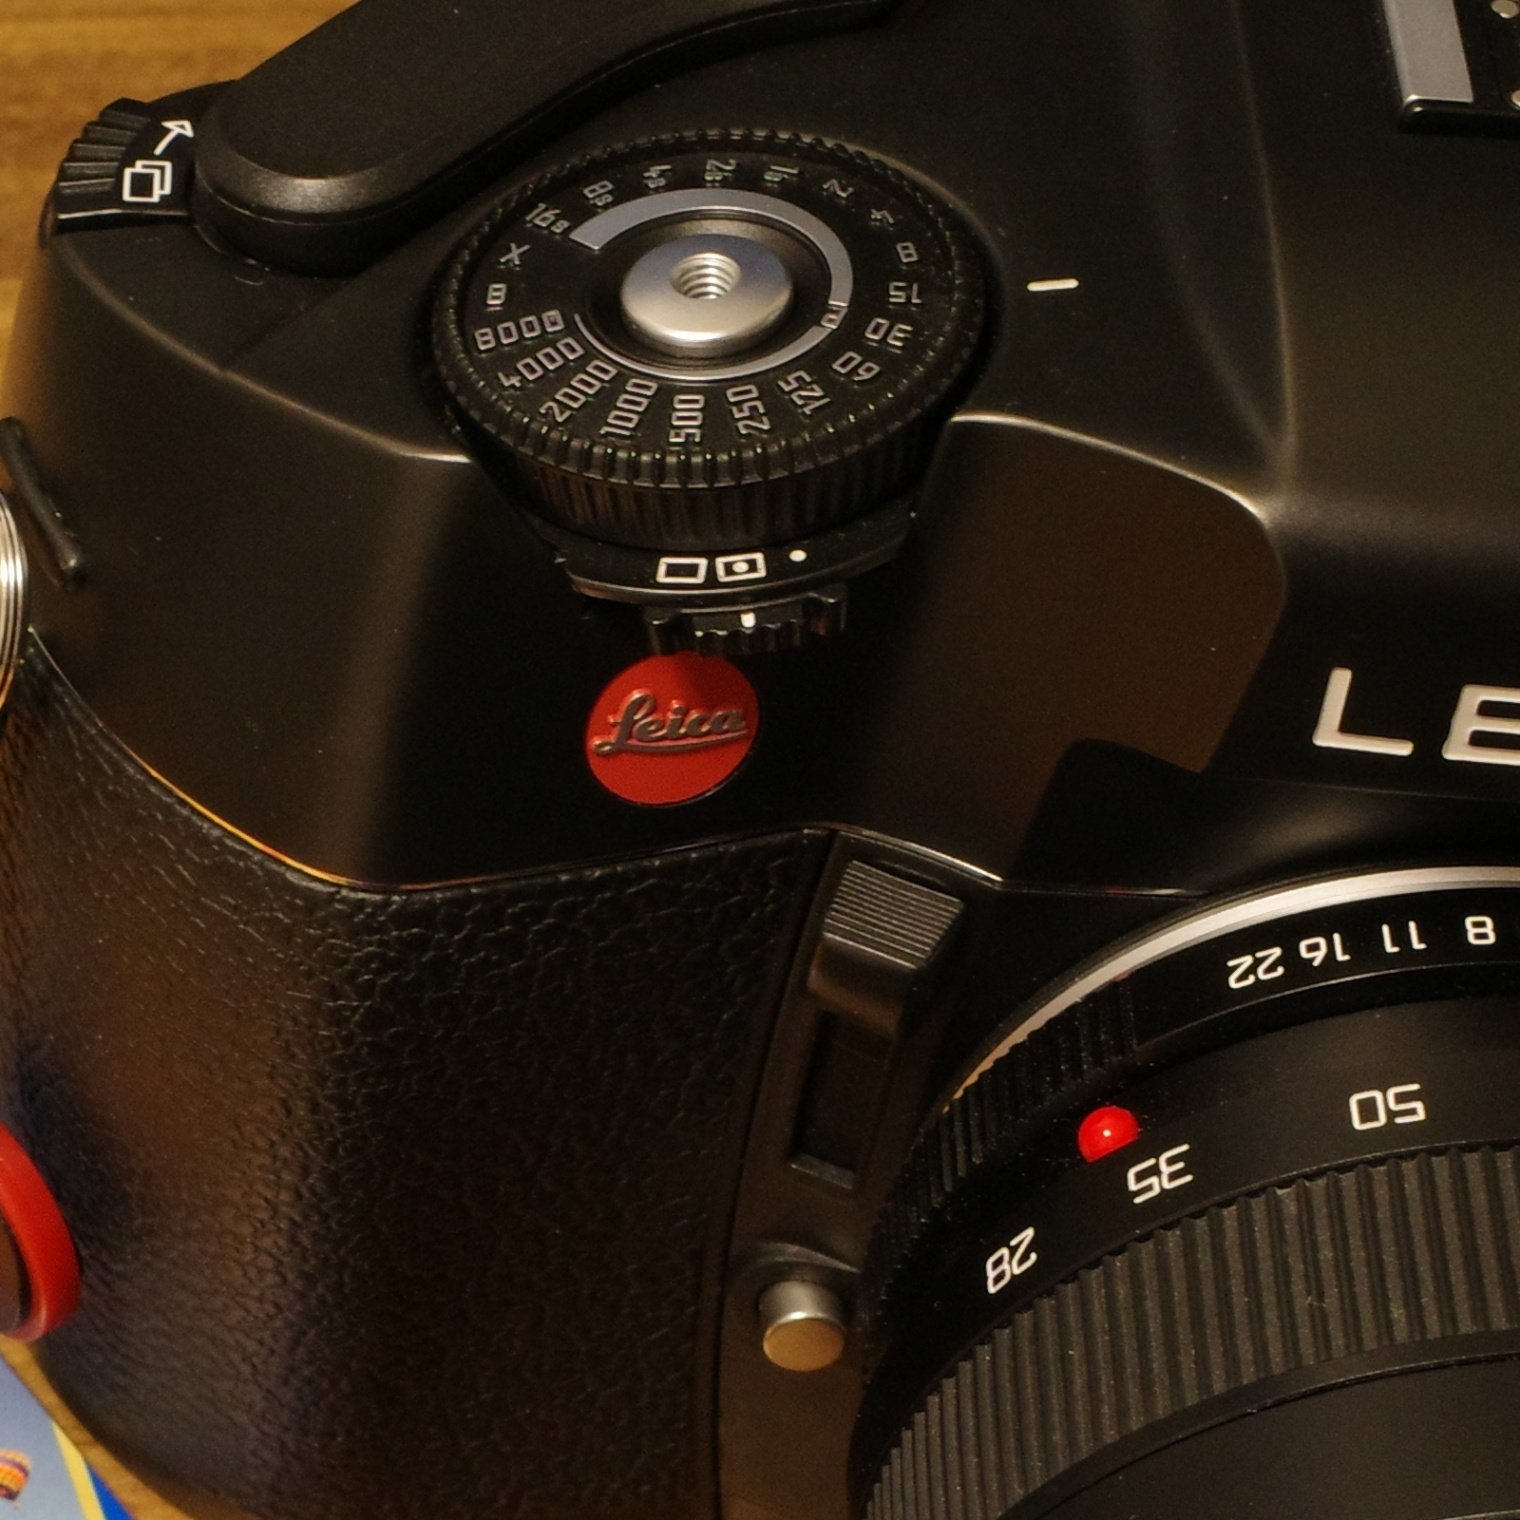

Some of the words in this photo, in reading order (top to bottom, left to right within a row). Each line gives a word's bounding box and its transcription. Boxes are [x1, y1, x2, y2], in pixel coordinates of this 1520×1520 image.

[888, 281, 922, 303] 15
[474, 309, 565, 351] 8000
[864, 317, 913, 346] 30
[497, 336, 585, 387] 4000
[831, 351, 881, 381] 60
[540, 359, 618, 423] 2000
[600, 378, 658, 435] 1000
[726, 384, 771, 435] 250
[777, 370, 830, 415] 125
[668, 394, 705, 442] 500
[592, 688, 747, 757] Leica
[1227, 945, 1284, 989] 22
[1299, 931, 1351, 967] 16
[1381, 919, 1428, 954] 11
[1464, 915, 1496, 946] 8
[985, 1227, 1038, 1294] 28
[1126, 1143, 1194, 1204] 35
[1348, 1083, 1427, 1131] 50
